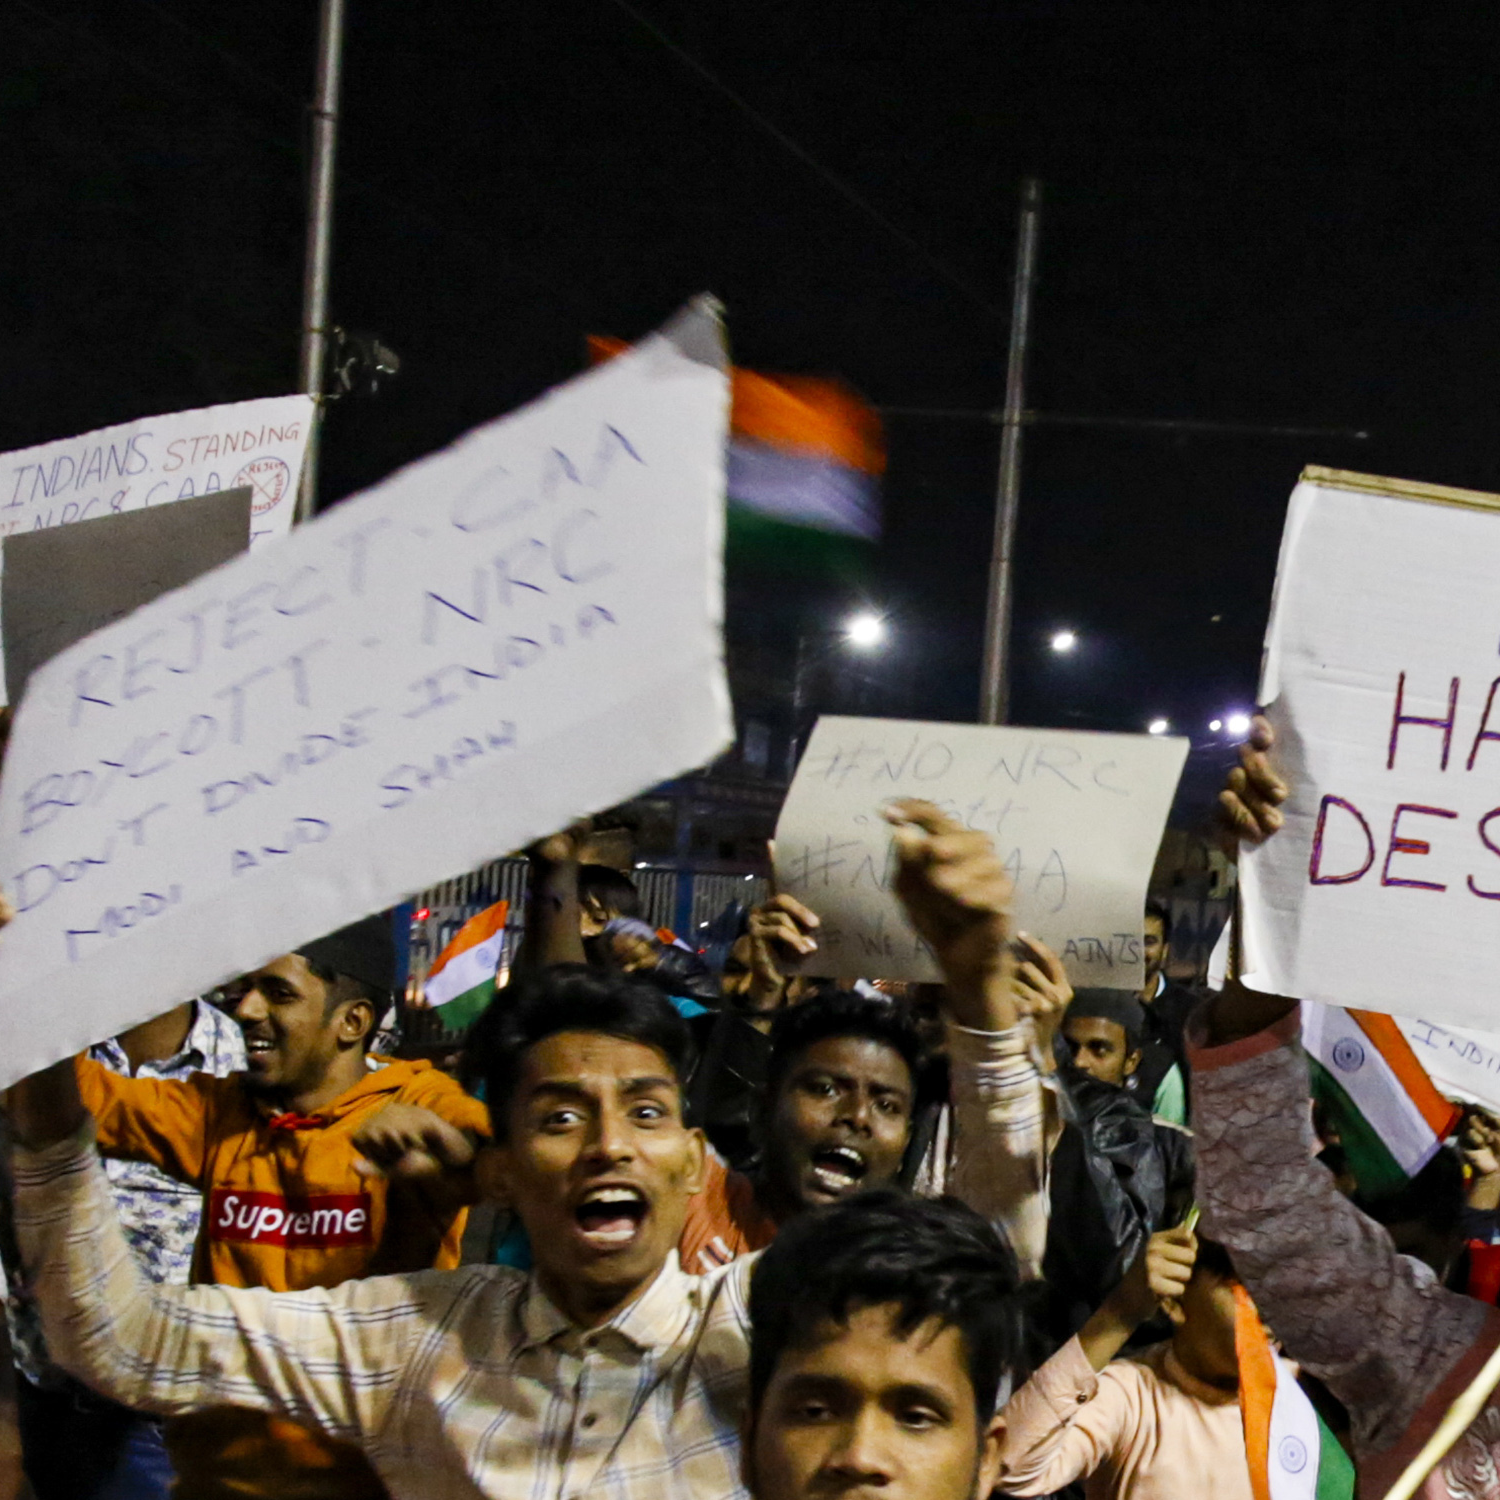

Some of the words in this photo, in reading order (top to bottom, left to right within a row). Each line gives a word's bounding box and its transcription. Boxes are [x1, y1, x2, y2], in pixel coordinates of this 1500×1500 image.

[162, 422, 301, 473] STANDING
[19, 636, 331, 836] BOYCOTT
[422, 507, 617, 646] NRC
[68, 516, 393, 728] REJECT
[201, 704, 379, 816] DIVIDE
[402, 604, 618, 719] INDIA
[63, 883, 184, 964] MODI
[231, 816, 334, 878] AND
[218, 1194, 367, 1240] Supreme
